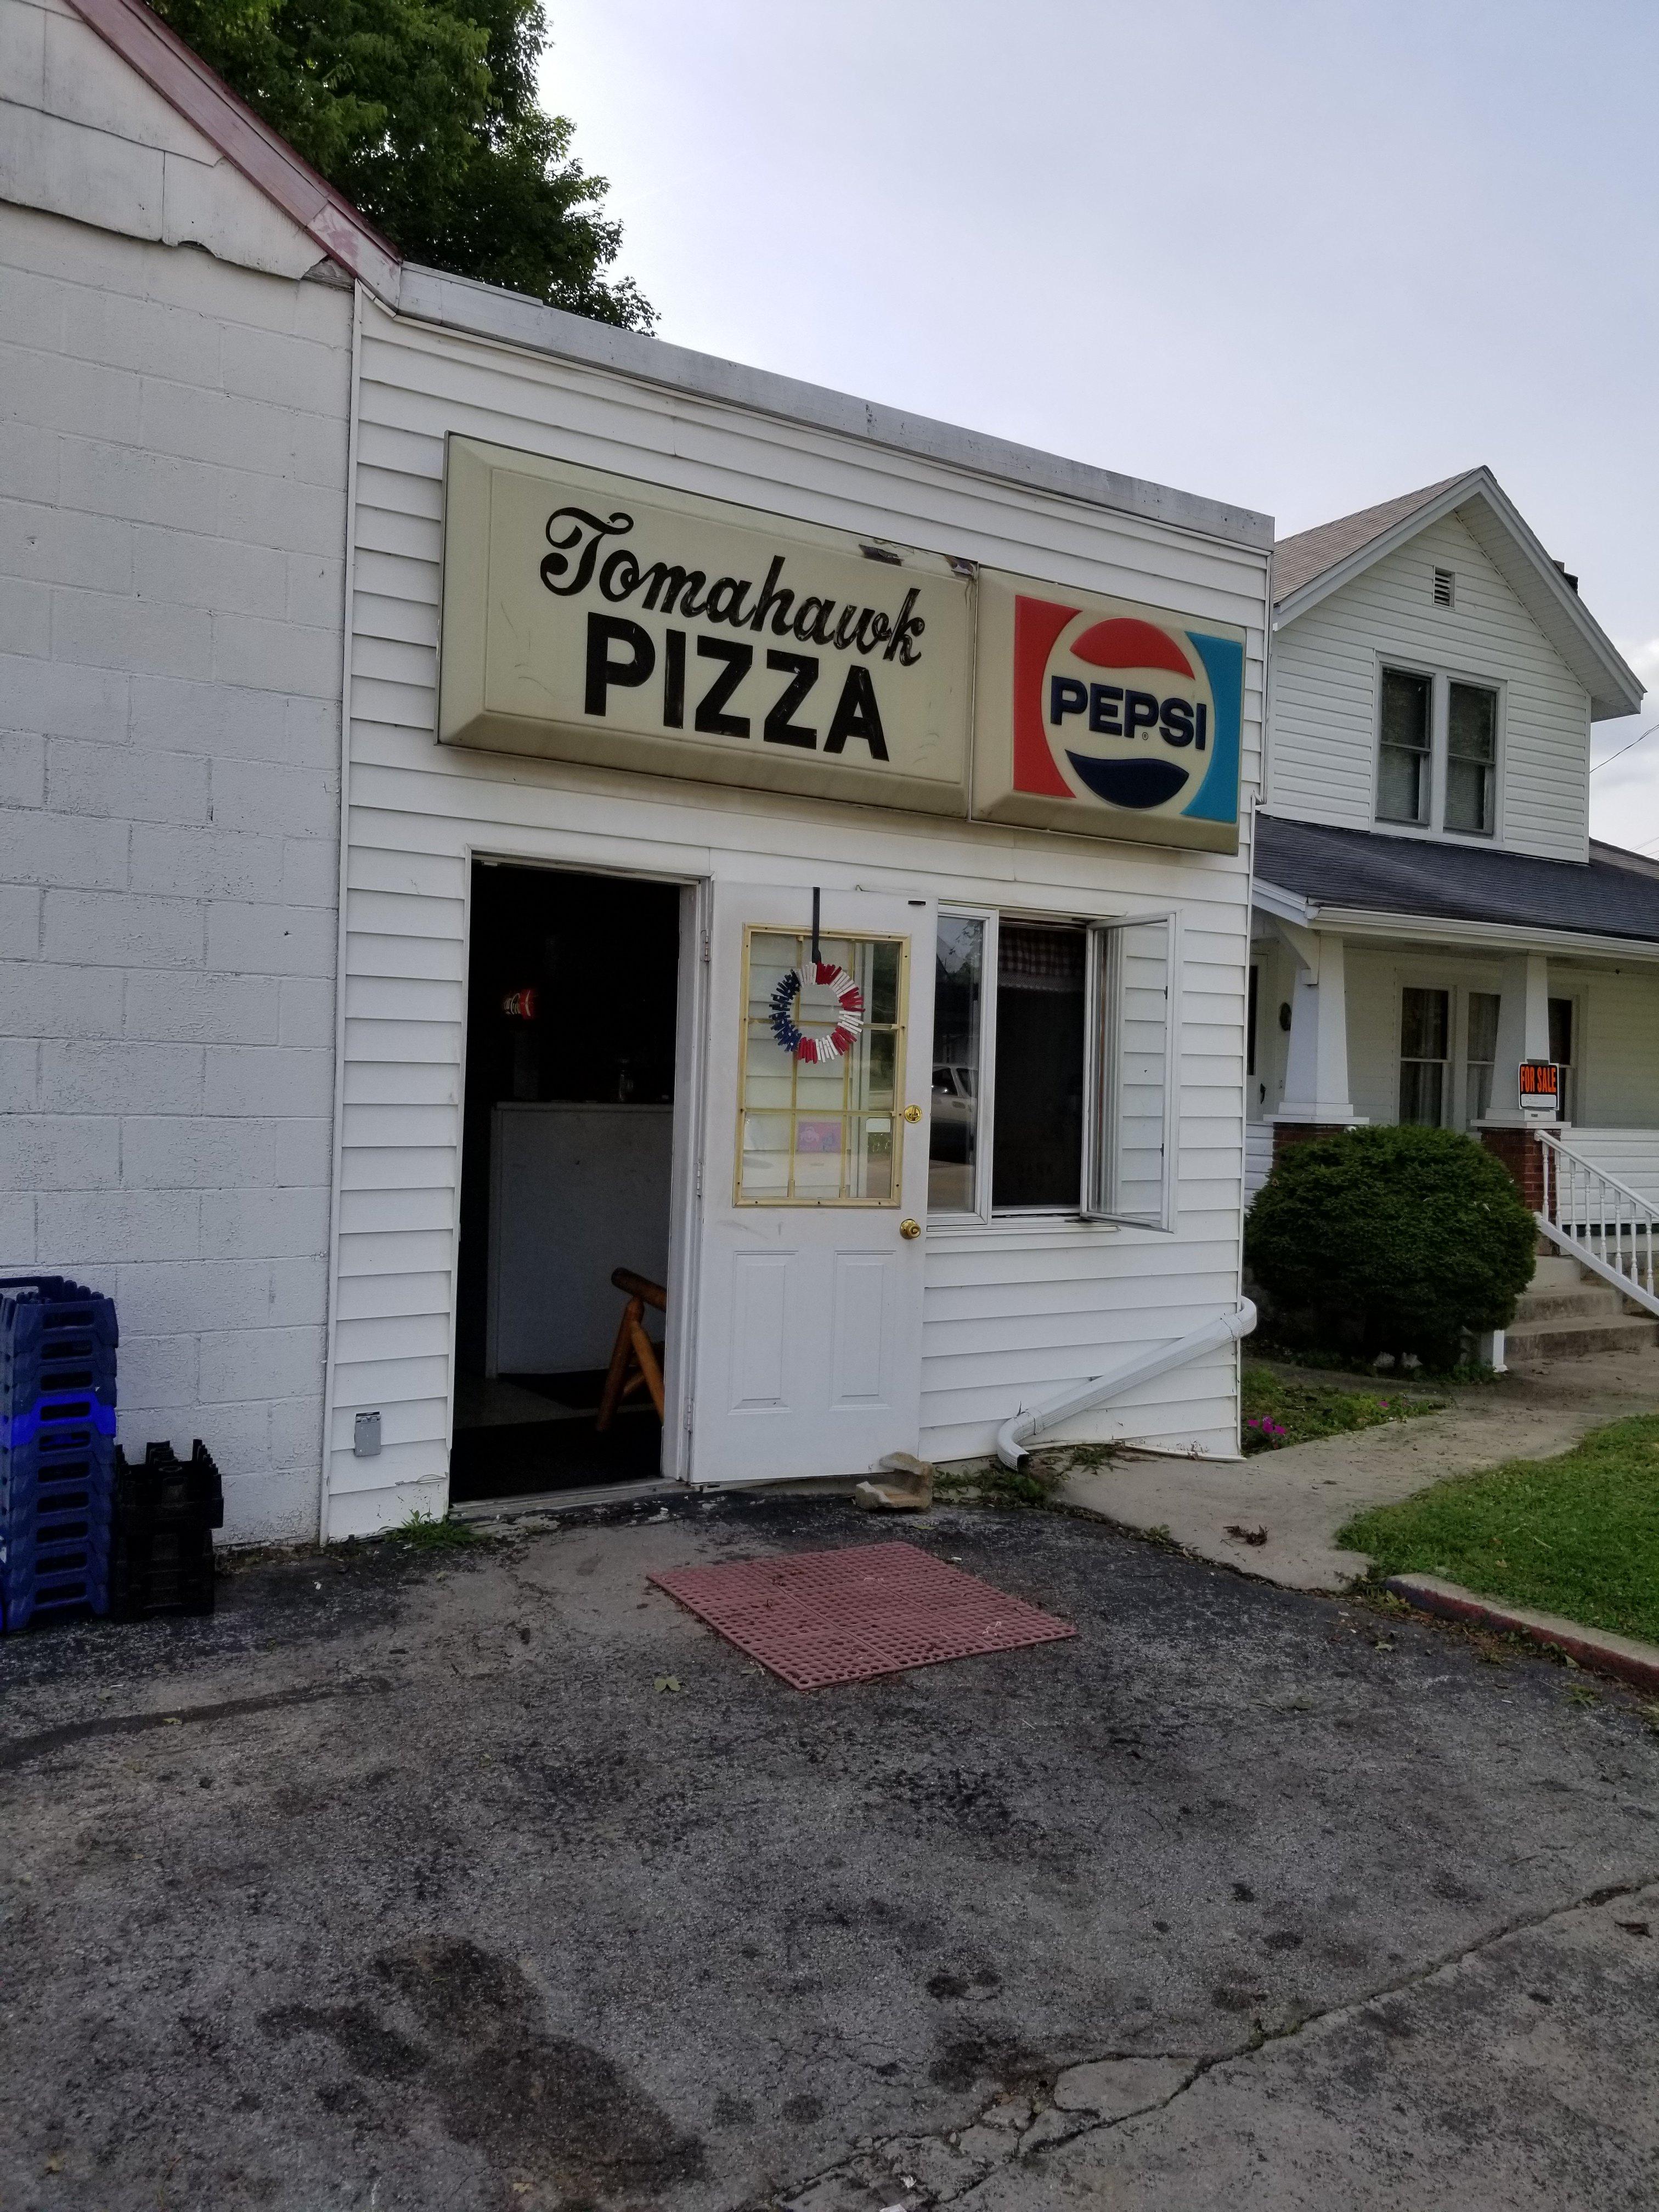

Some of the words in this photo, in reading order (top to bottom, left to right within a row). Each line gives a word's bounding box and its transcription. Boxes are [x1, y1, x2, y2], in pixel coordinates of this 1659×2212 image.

[540, 507, 925, 666] Tomahawk
[585, 612, 889, 761] PIZZA
[1051, 675, 1207, 751] PEPSI
[1520, 1066, 1535, 1092] FOR
[1537, 1066, 1556, 1092] SALE
